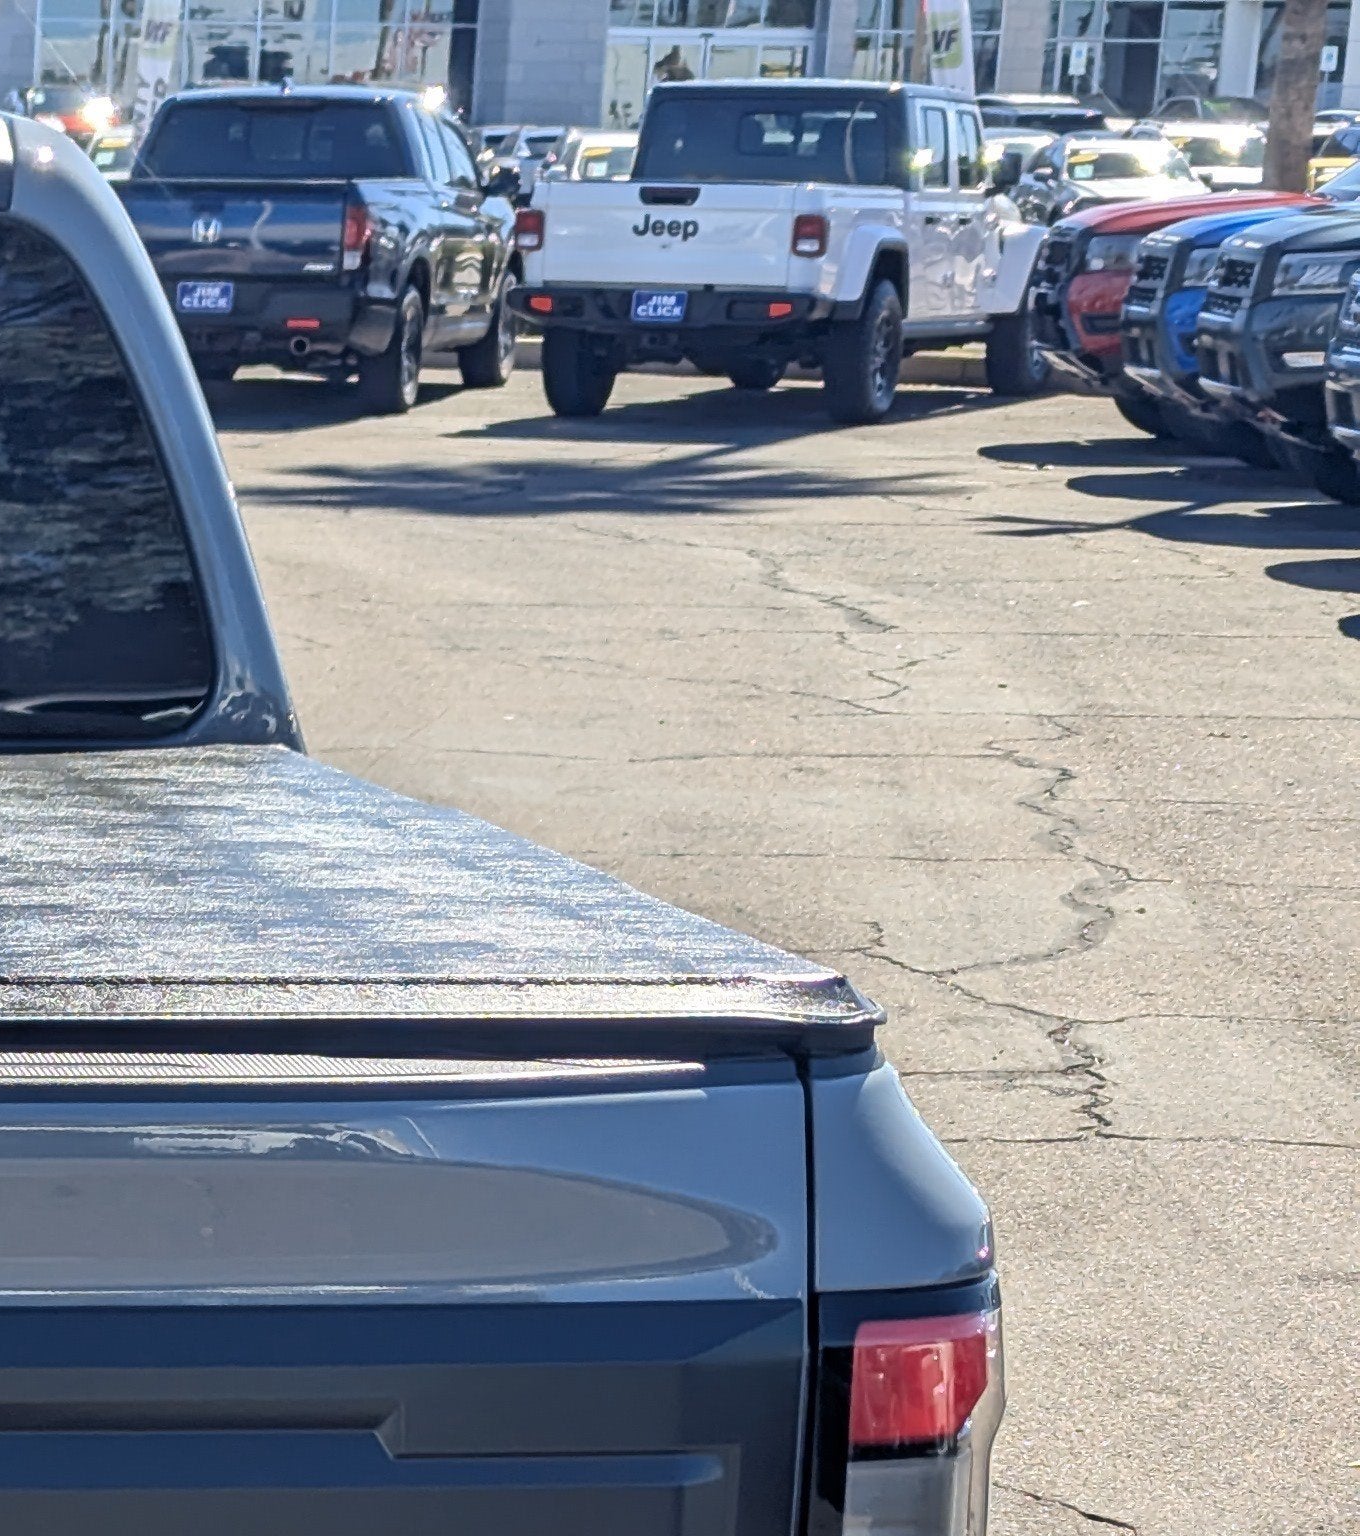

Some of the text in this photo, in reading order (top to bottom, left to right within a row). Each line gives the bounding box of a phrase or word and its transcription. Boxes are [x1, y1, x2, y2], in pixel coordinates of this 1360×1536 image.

[632, 213, 698, 241] Jeep
[648, 295, 677, 306] JIM
[636, 305, 682, 317] CLICK
